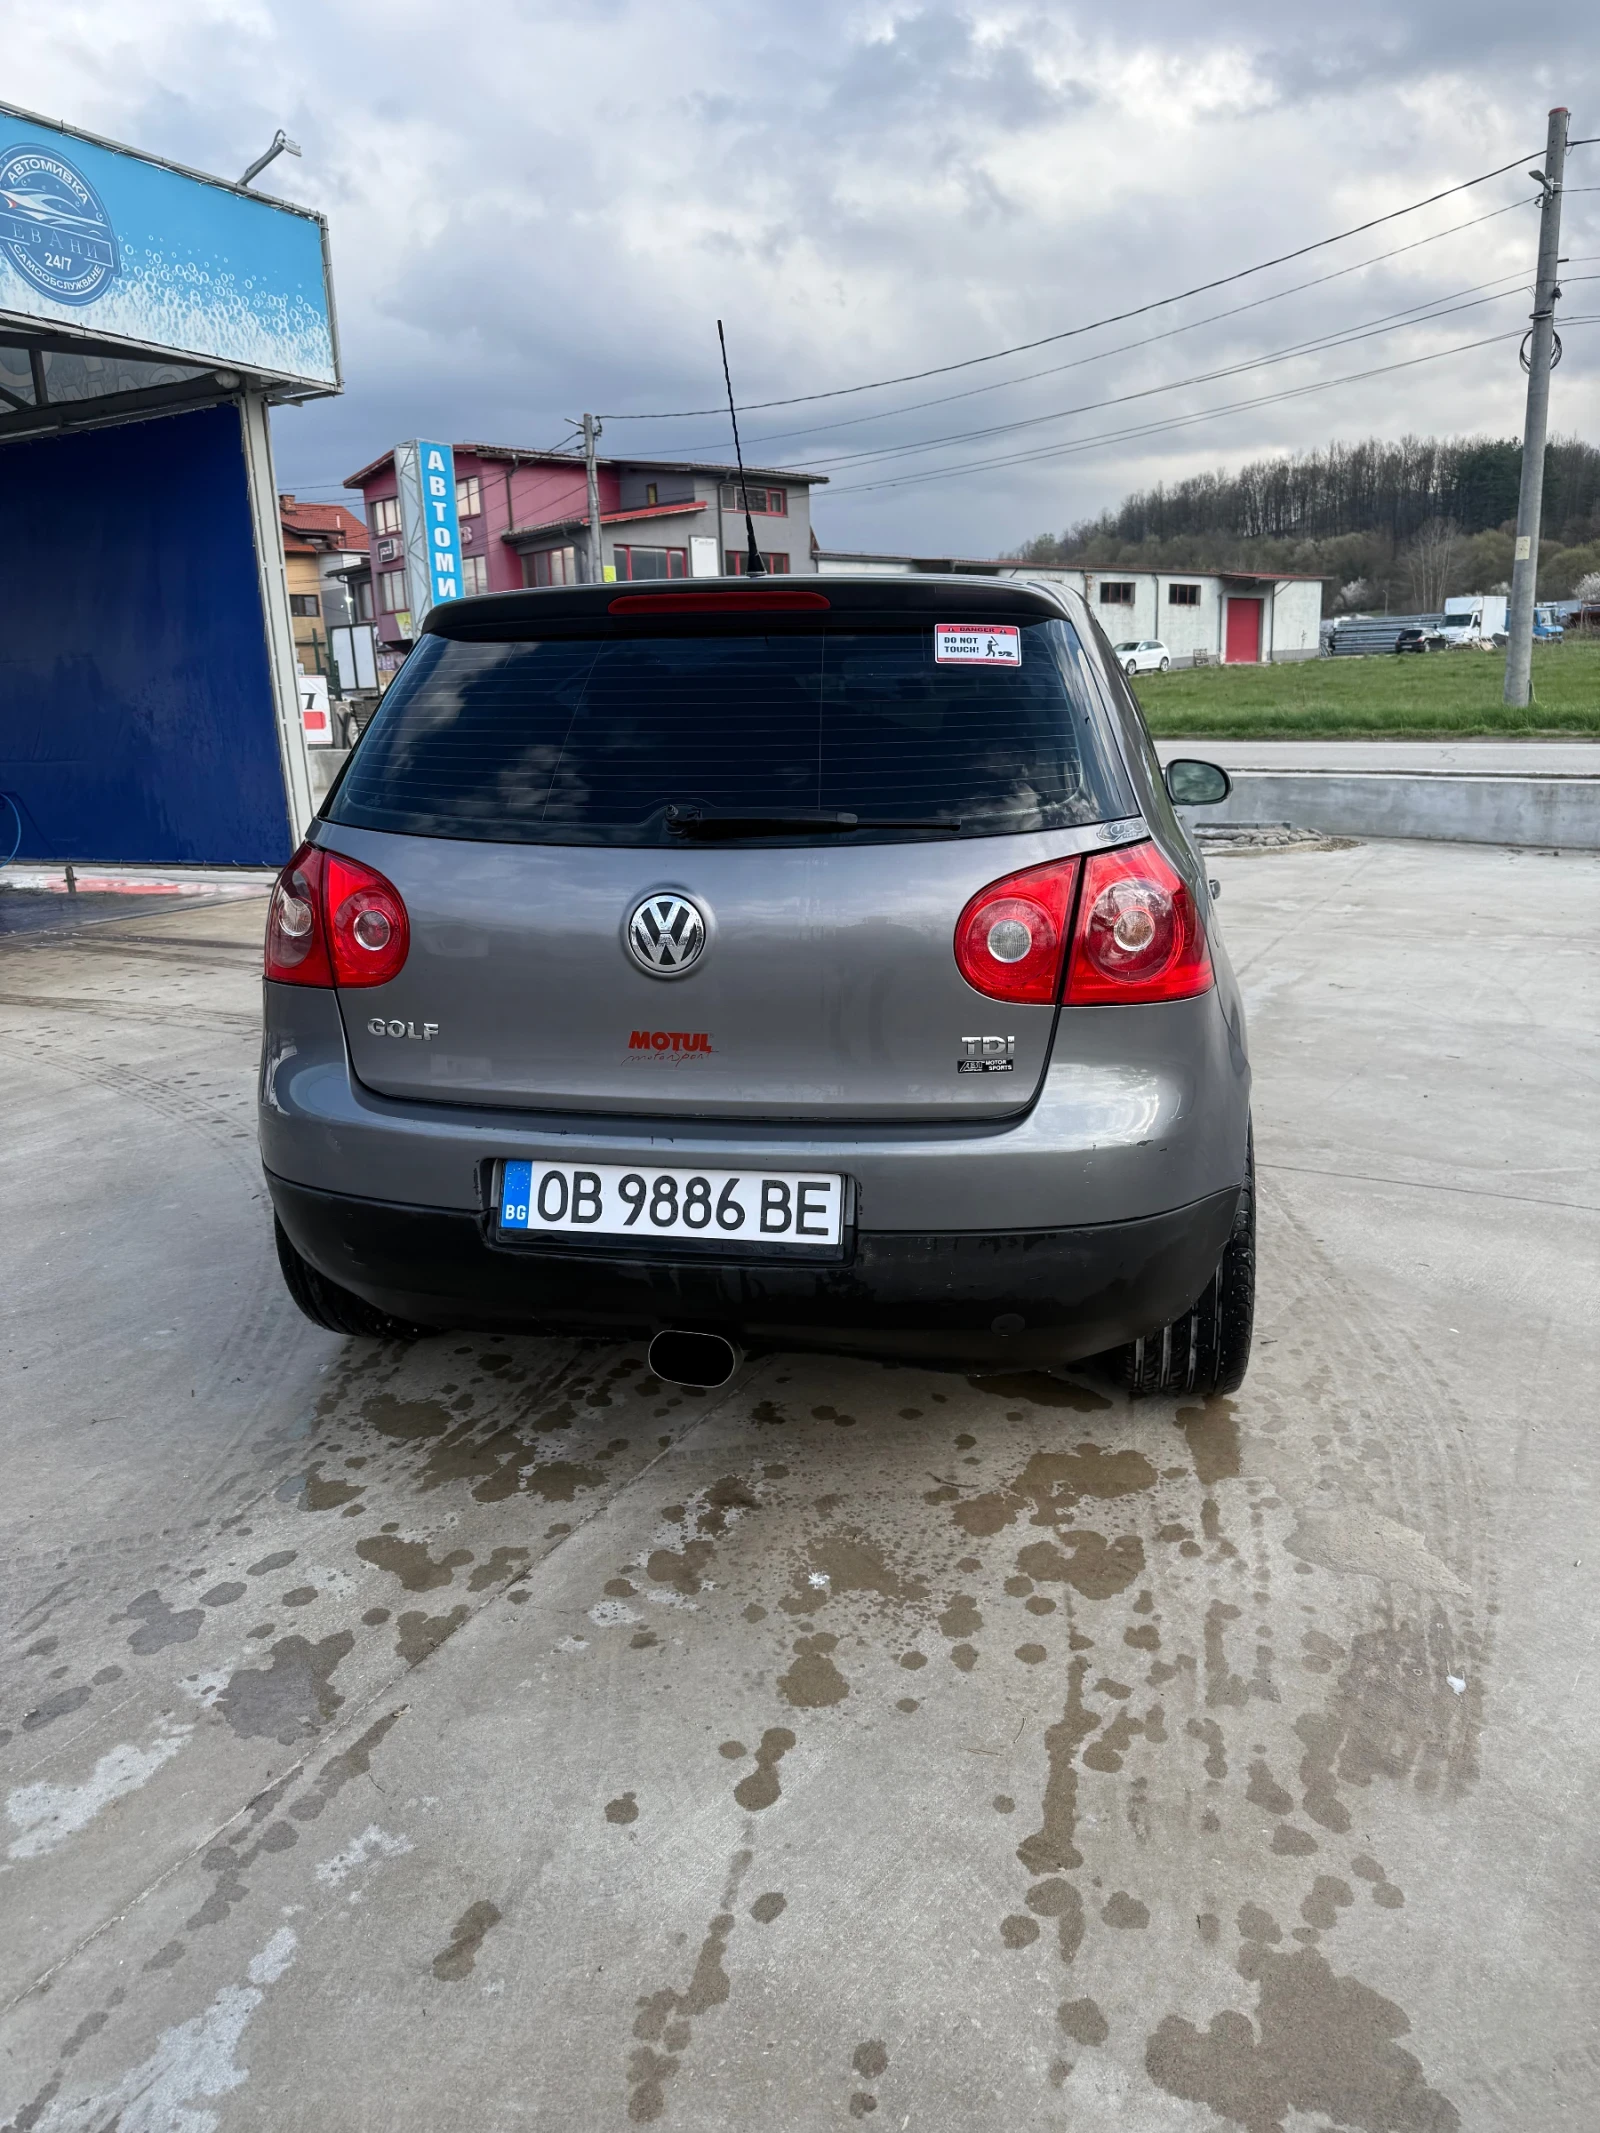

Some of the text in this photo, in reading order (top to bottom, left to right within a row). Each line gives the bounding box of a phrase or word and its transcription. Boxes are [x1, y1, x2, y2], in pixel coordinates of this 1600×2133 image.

[7, 158, 88, 206] АВТОМИВКА
[13, 243, 102, 290] САМООБСЛУЖВАНЕ
[44, 252, 72, 271] 24/7
[427, 450, 457, 598] АВТОМИ
[944, 636, 978, 645] DO NOT
[944, 645, 979, 654] TOUCH!
[367, 1017, 439, 1041] GOLF
[628, 1030, 713, 1053] MOTUL
[505, 1203, 527, 1221] BG
[617, 1173, 746, 1231] 9886
[759, 1179, 831, 1236] BE
